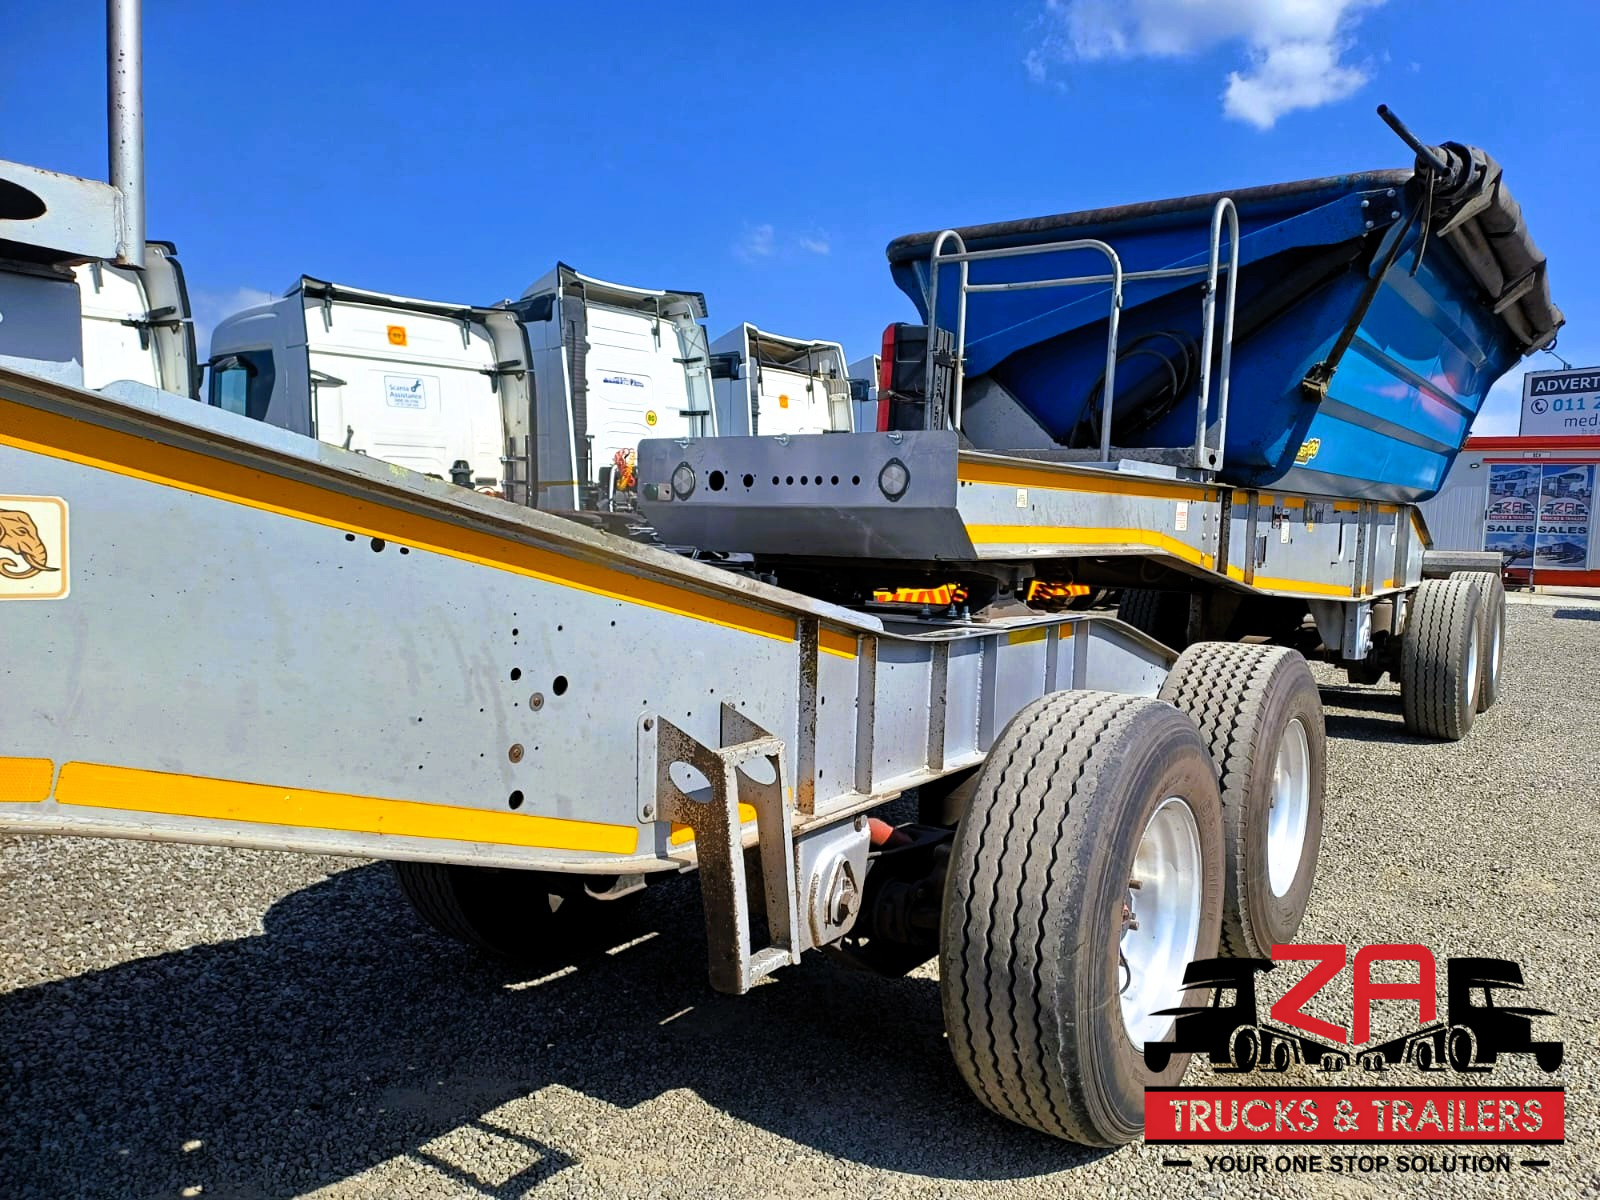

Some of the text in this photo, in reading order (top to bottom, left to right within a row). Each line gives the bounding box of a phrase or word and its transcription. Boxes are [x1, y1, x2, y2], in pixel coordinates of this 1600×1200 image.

[389, 384, 410, 392] Scania
[1535, 376, 1600, 392] ADVERT
[389, 391, 423, 400] Assistance
[1552, 397, 1585, 412] 011
[1564, 413, 1600, 428] med
[1503, 501, 1522, 512] ZA
[1555, 502, 1575, 513] ZA
[1538, 526, 1587, 534] SALES
